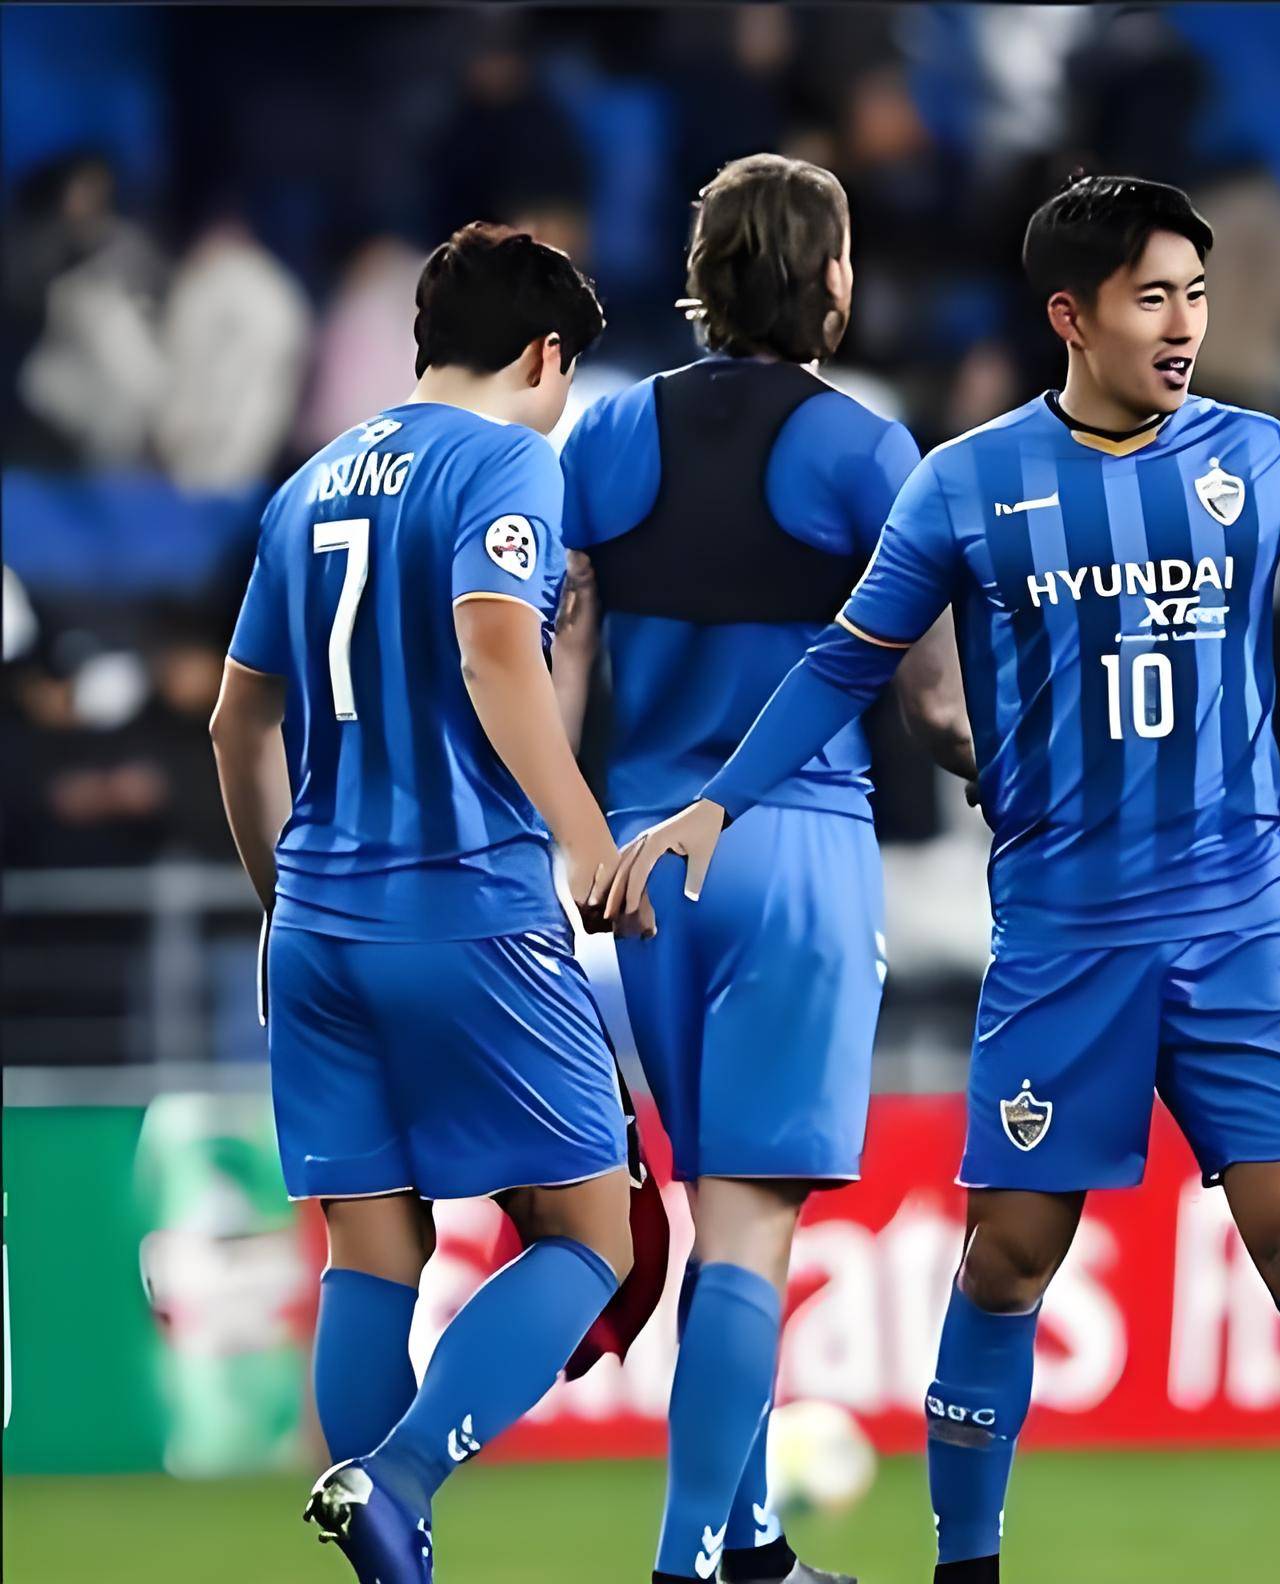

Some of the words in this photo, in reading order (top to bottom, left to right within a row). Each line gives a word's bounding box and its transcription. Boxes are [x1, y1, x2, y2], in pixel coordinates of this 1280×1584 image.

[313, 518, 370, 721] 7
[1027, 556, 1233, 607] HYUNDAI
[1101, 653, 1174, 740] 10
